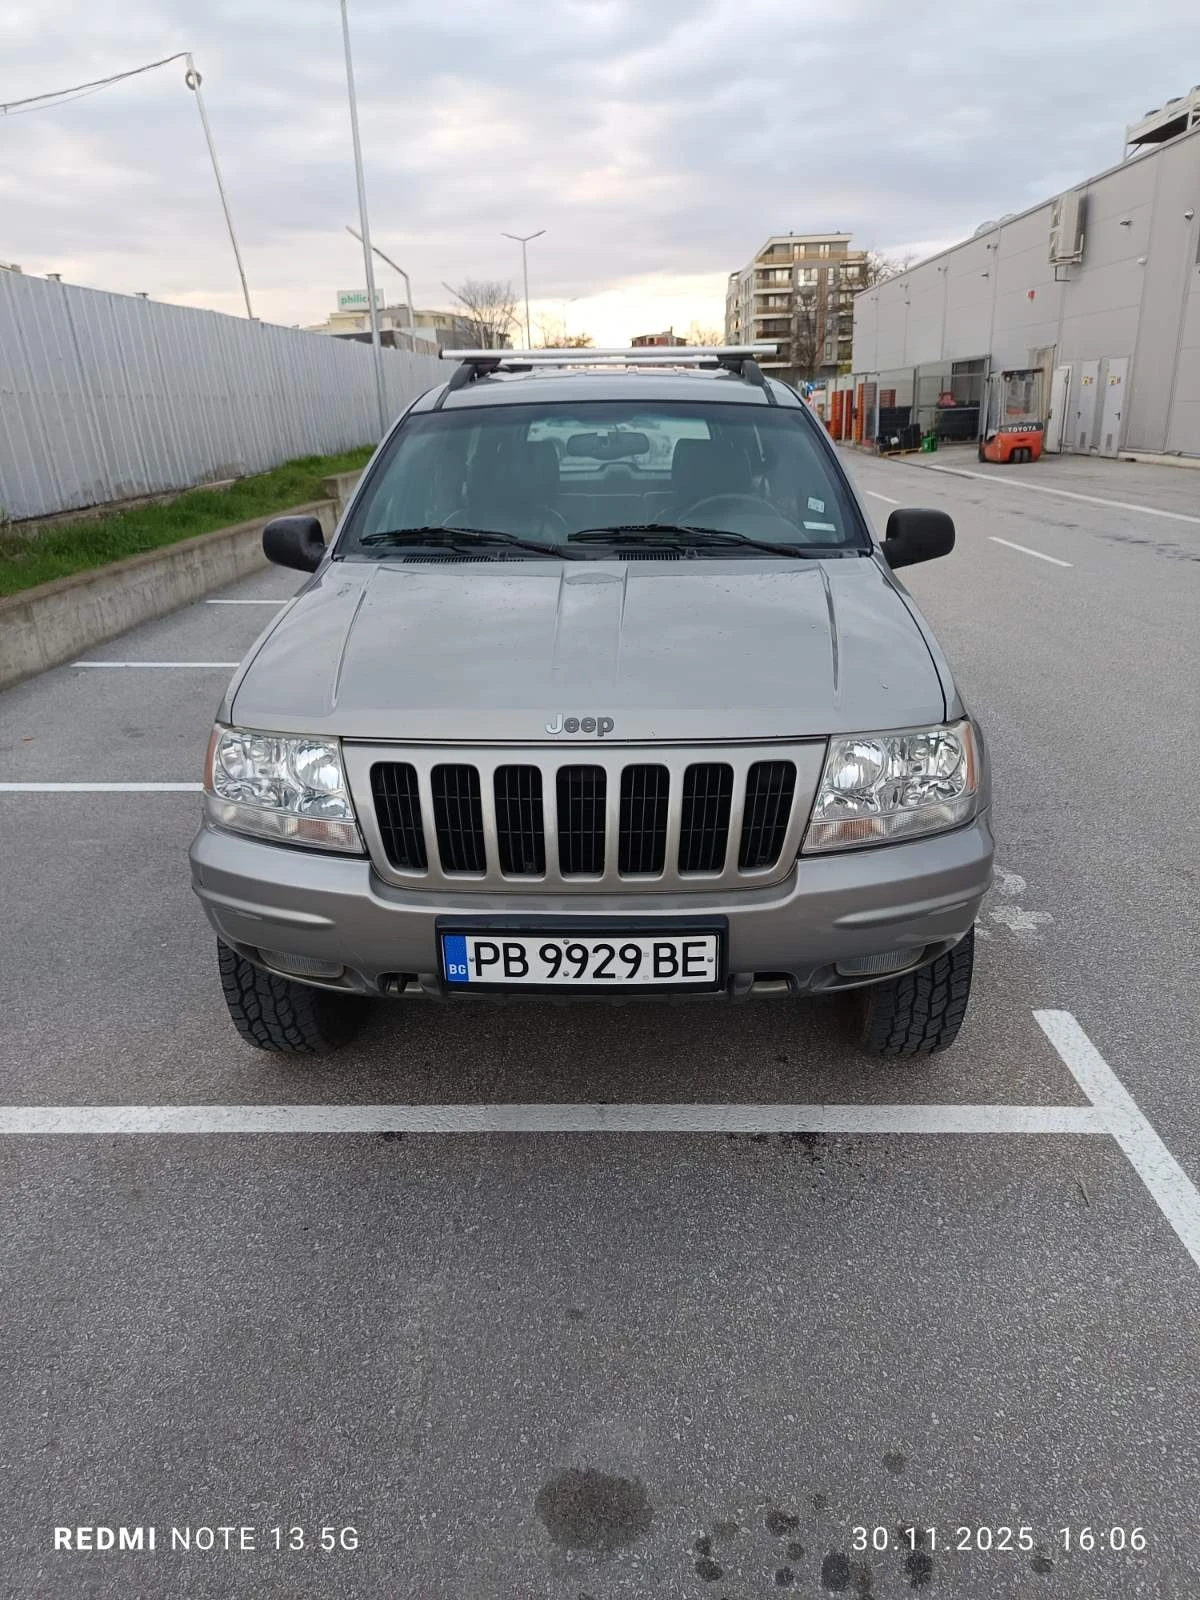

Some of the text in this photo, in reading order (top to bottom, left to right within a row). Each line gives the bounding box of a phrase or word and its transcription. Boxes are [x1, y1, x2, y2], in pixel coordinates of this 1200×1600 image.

[341, 294, 379, 305] philicn
[1008, 425, 1037, 433] TOYOTA
[545, 713, 614, 737] Jeep
[474, 941, 708, 979] PB 9929 BE
[449, 964, 466, 975] BG
